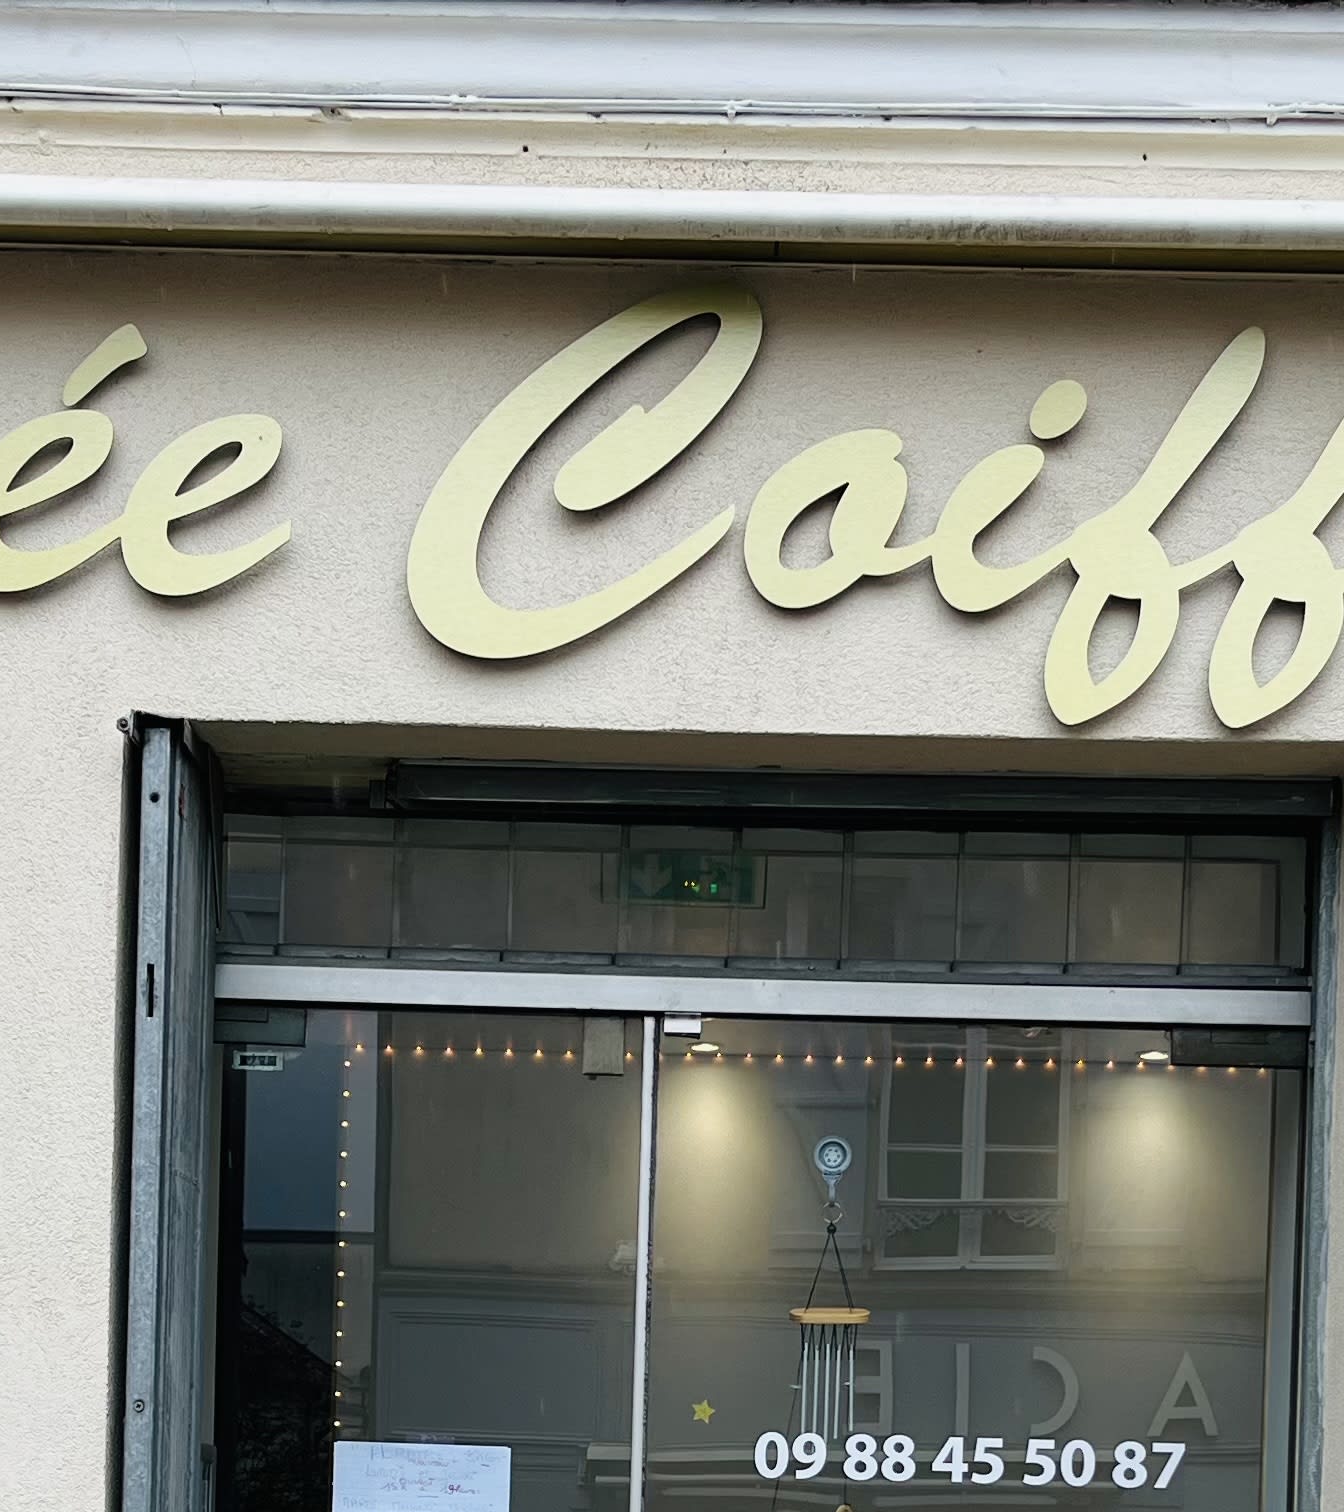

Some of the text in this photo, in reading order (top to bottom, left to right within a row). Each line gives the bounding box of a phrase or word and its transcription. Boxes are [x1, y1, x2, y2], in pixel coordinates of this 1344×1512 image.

[754, 1431, 1186, 1489] 09 88 45 50 87
